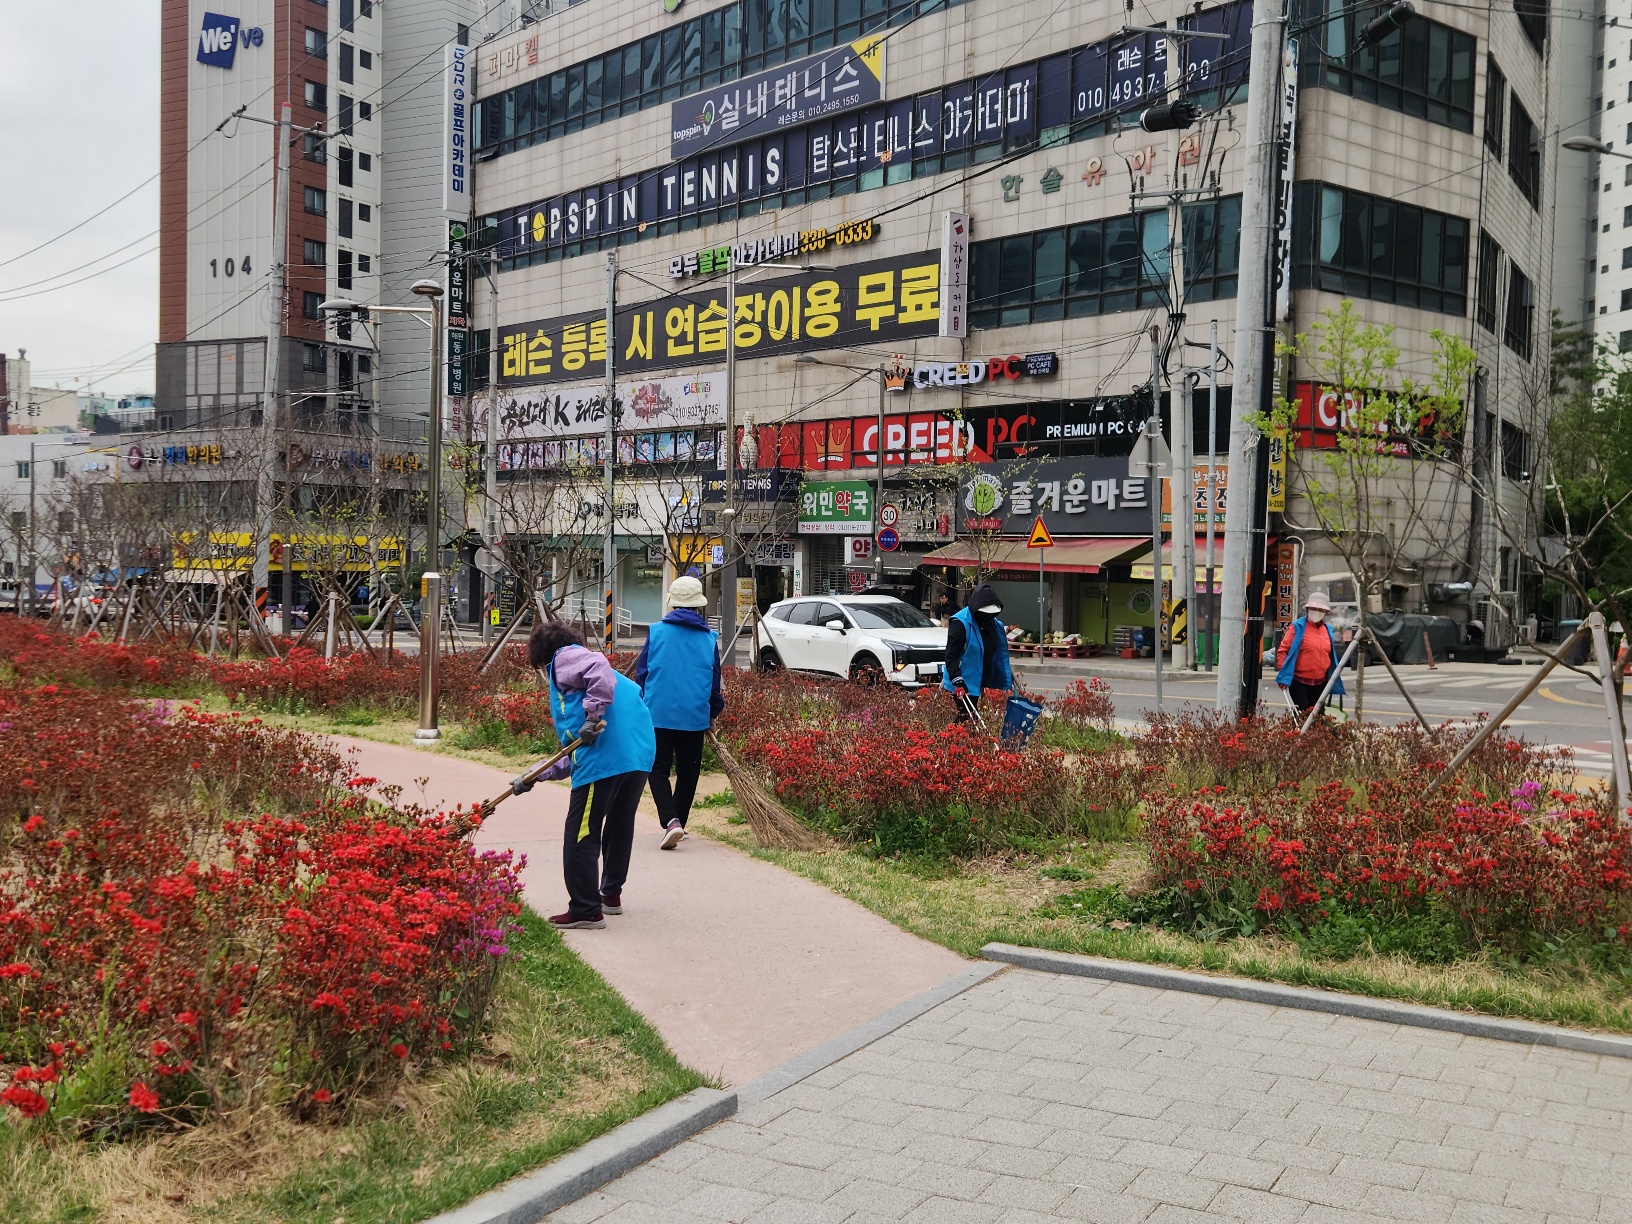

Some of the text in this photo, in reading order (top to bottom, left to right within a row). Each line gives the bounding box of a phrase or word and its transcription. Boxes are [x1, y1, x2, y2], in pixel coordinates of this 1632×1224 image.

[201, 24, 263, 53] We've
[863, 40, 879, 58] 4F
[1117, 46, 1142, 71] 레슨
[718, 56, 860, 130] 실내테니스
[1078, 89, 1103, 111] 010
[673, 125, 701, 140] topspin
[778, 110, 805, 125] 레슨문의
[812, 79, 1031, 175] 탑스핀 테니스 아카데미
[452, 103, 465, 193] 골프아카데미
[517, 147, 780, 246] TOPSPIN TENNIS
[669, 219, 873, 278] 모두골프아카데미 330-0333
[210, 255, 252, 278] 104
[952, 241, 964, 313] 하삼동 커피
[503, 263, 942, 377] 레슨 등록 시 연습장이용 무료
[452, 341, 462, 394] 동물병원
[913, 355, 1021, 389] CREED PC
[554, 394, 571, 427] K
[863, 414, 1037, 463] CREED PC
[1046, 423, 1104, 438] PREMIUM
[1107, 421, 1125, 434] PC
[743, 479, 772, 490] TENNIS
[1010, 478, 1148, 515] 즐거운마트
[803, 490, 868, 517] 위민약국
[883, 510, 895, 521] 30
[852, 539, 870, 558] 약
